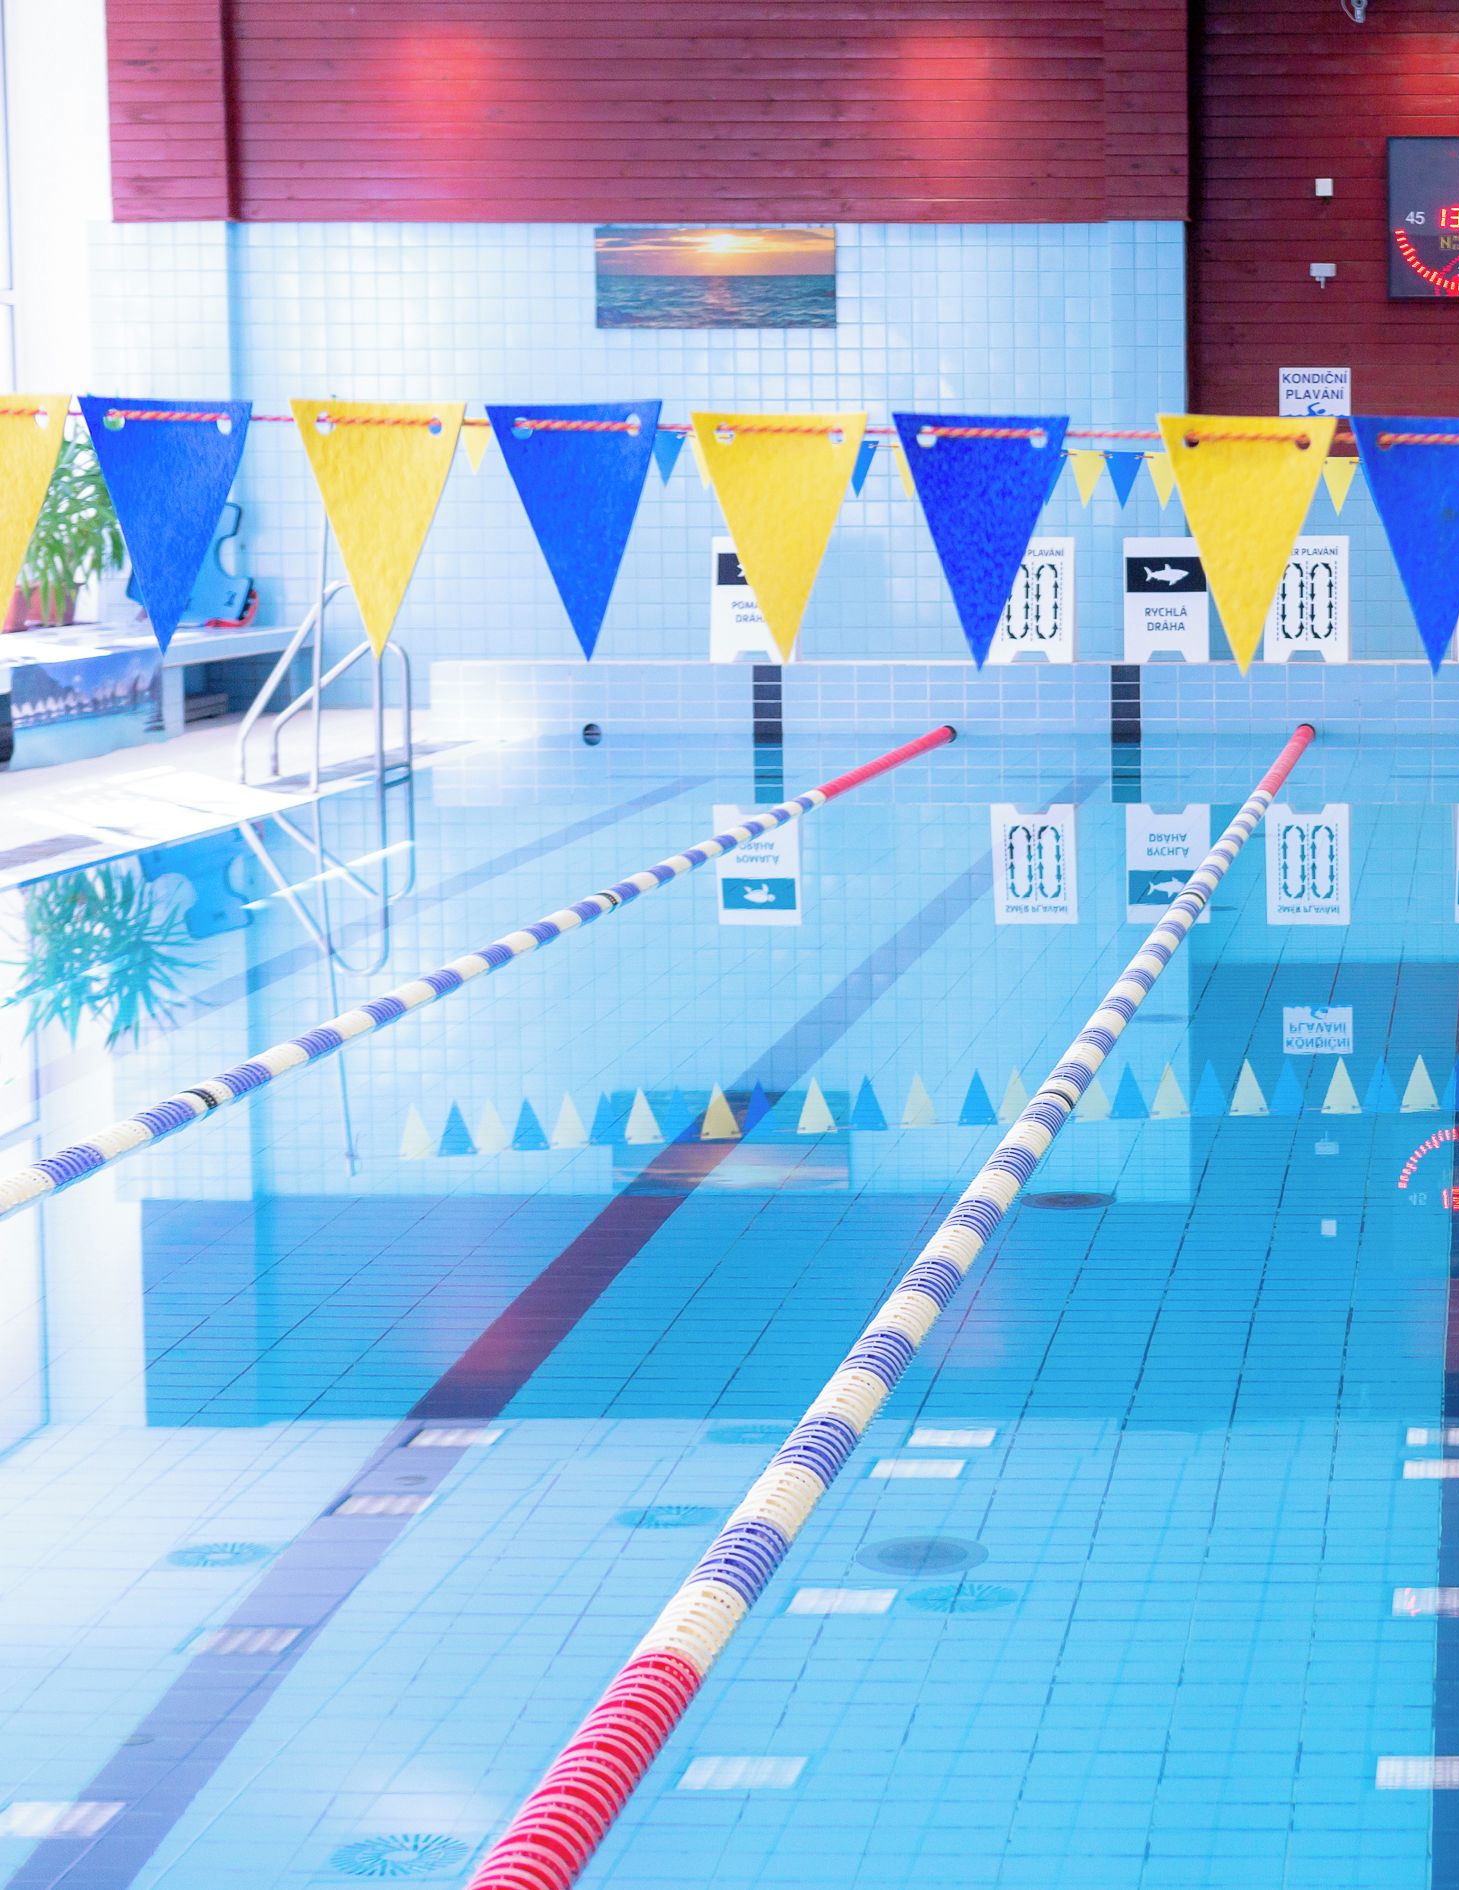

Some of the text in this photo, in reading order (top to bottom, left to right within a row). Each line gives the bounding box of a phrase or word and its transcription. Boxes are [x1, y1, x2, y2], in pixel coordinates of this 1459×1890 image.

[1405, 211, 1426, 225] 45
[1282, 370, 1348, 384] KONDIČNÍ
[1286, 386, 1344, 400] PLAVÁNÍ
[1144, 604, 1188, 617] RYCHLÁ
[1147, 619, 1186, 631] DRÁHA
